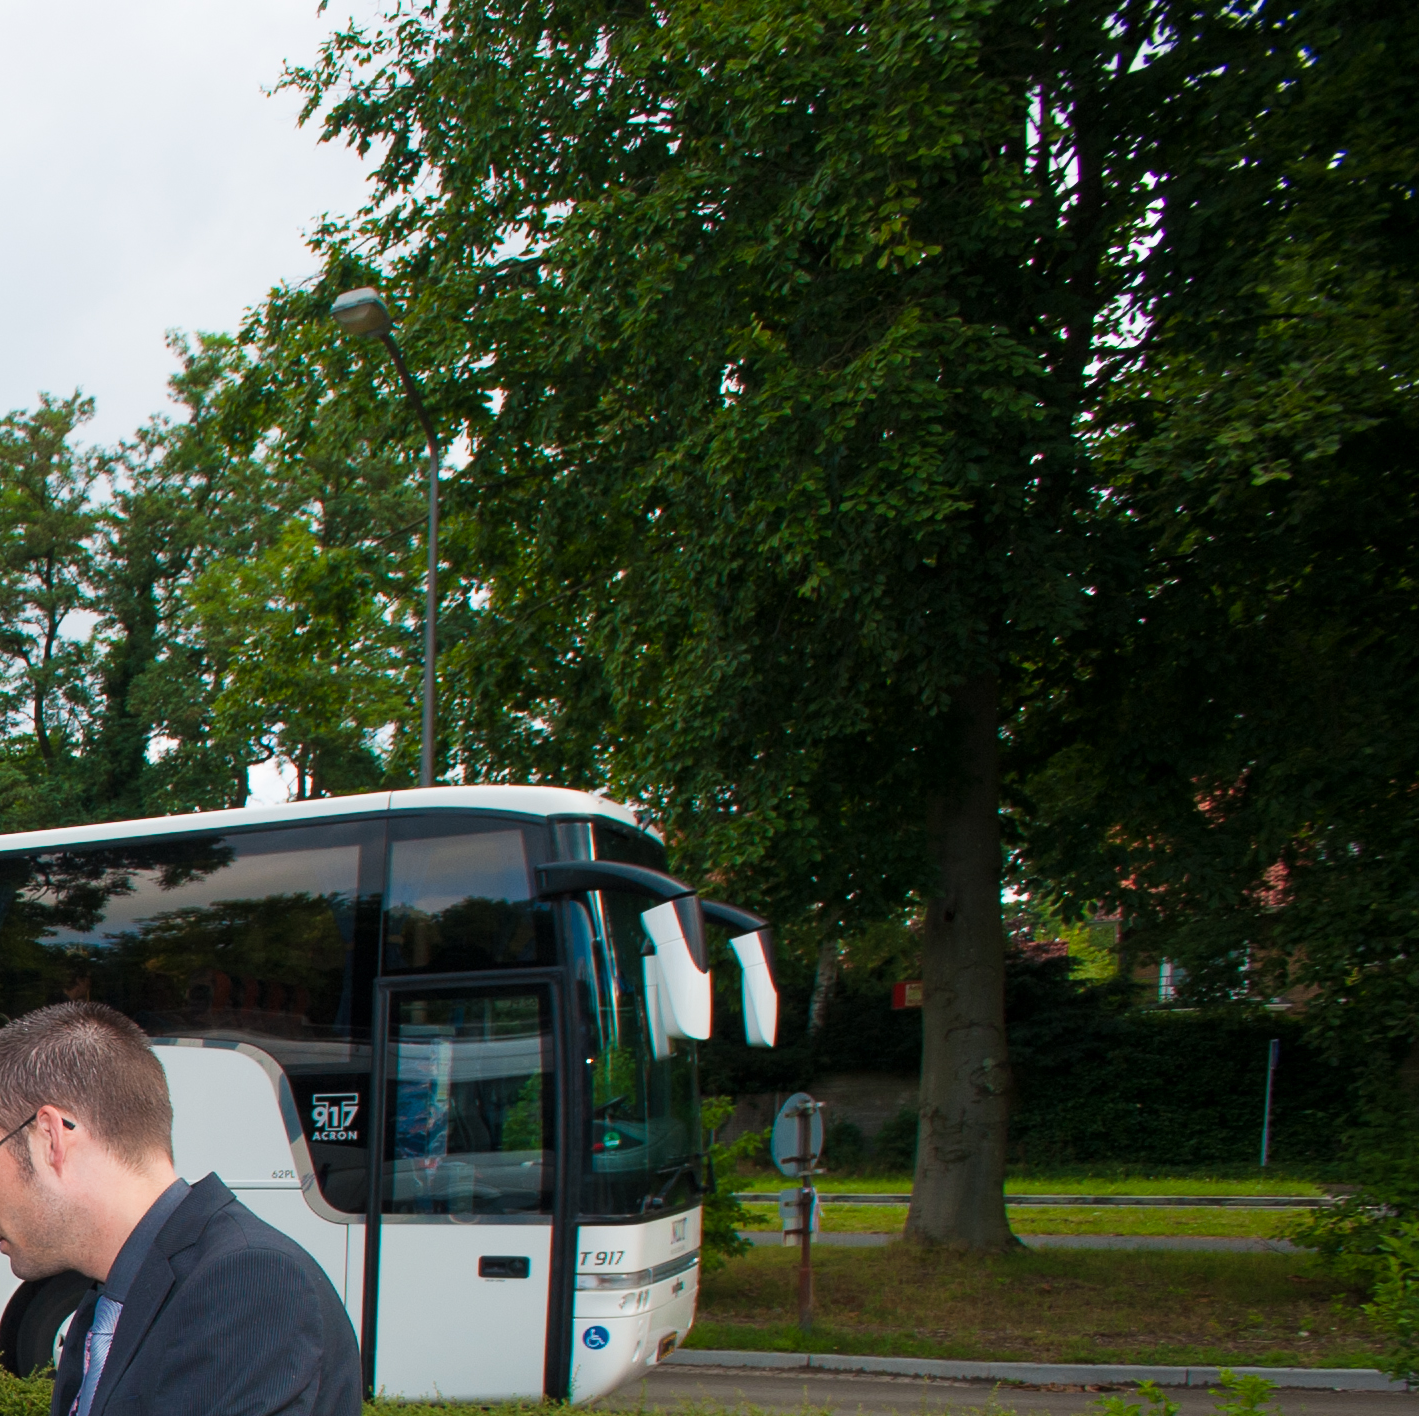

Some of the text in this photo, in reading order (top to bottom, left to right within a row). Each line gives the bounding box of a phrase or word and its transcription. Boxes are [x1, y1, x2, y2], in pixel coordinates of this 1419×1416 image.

[312, 1105, 359, 1127] 917
[312, 1131, 358, 1141] ACRON
[271, 1170, 295, 1178] 62PL
[580, 1251, 625, 1266] T 917
